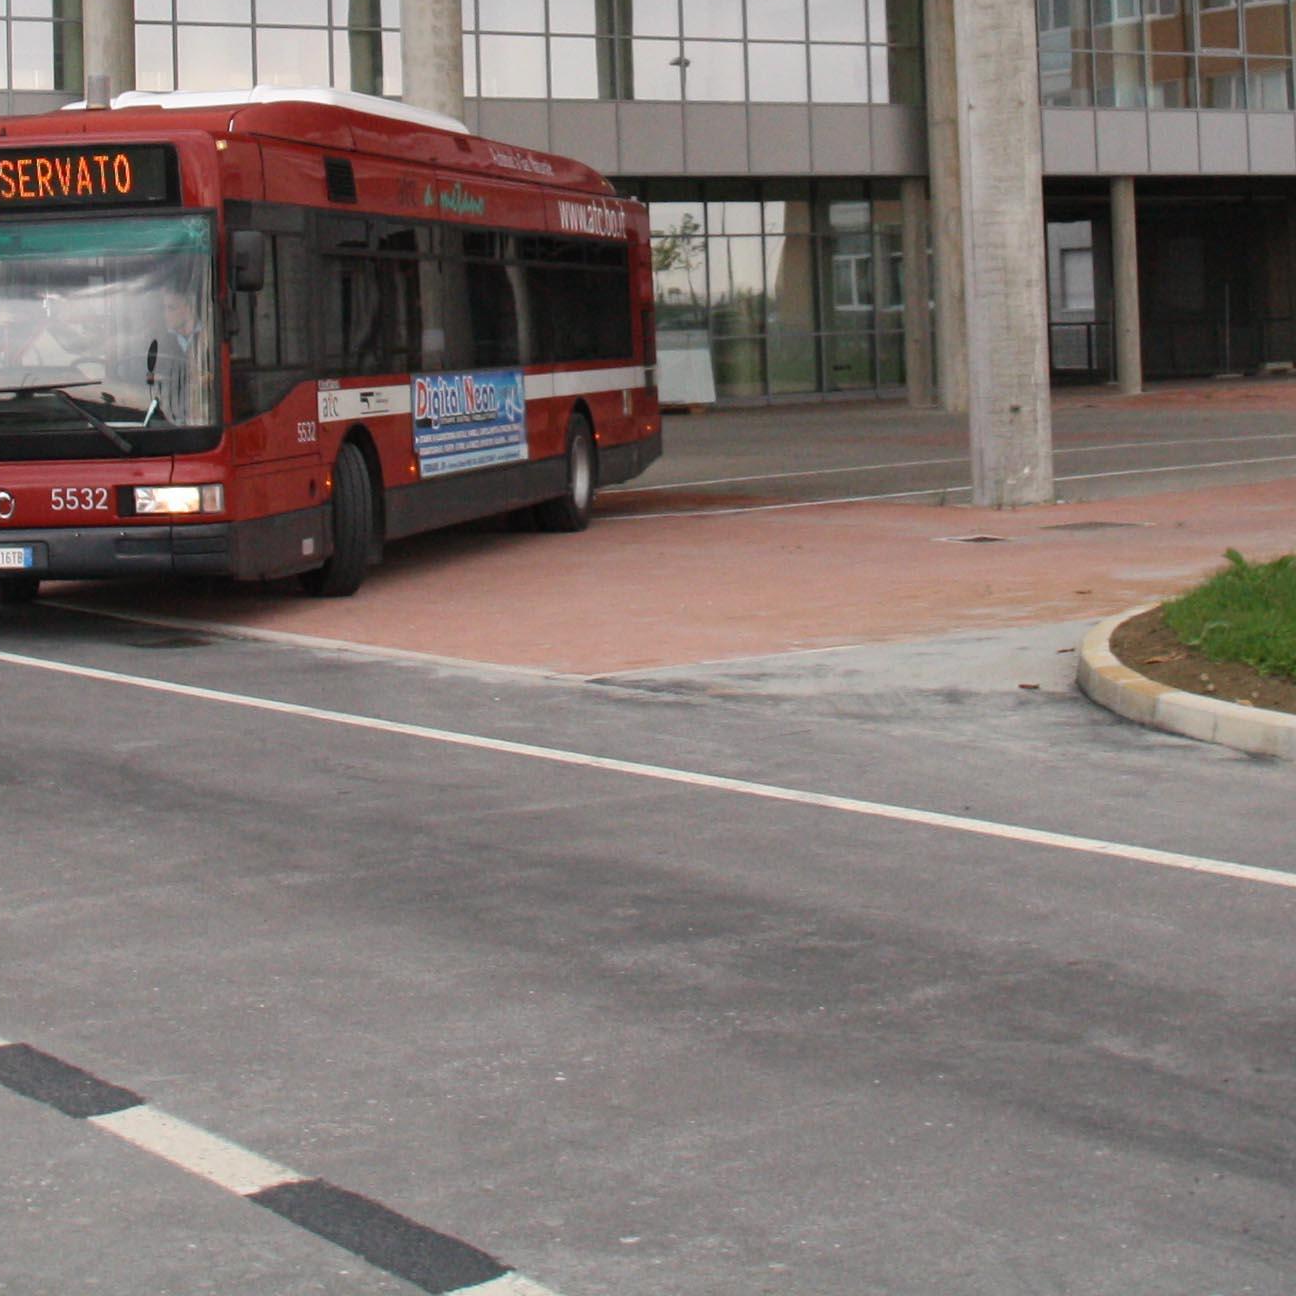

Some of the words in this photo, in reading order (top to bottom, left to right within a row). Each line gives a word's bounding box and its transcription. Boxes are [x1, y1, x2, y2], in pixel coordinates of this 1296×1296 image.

[415, 375, 463, 430] Digital
[462, 374, 498, 415] Neon
[296, 421, 317, 443] 5532
[50, 487, 109, 511] 5532
